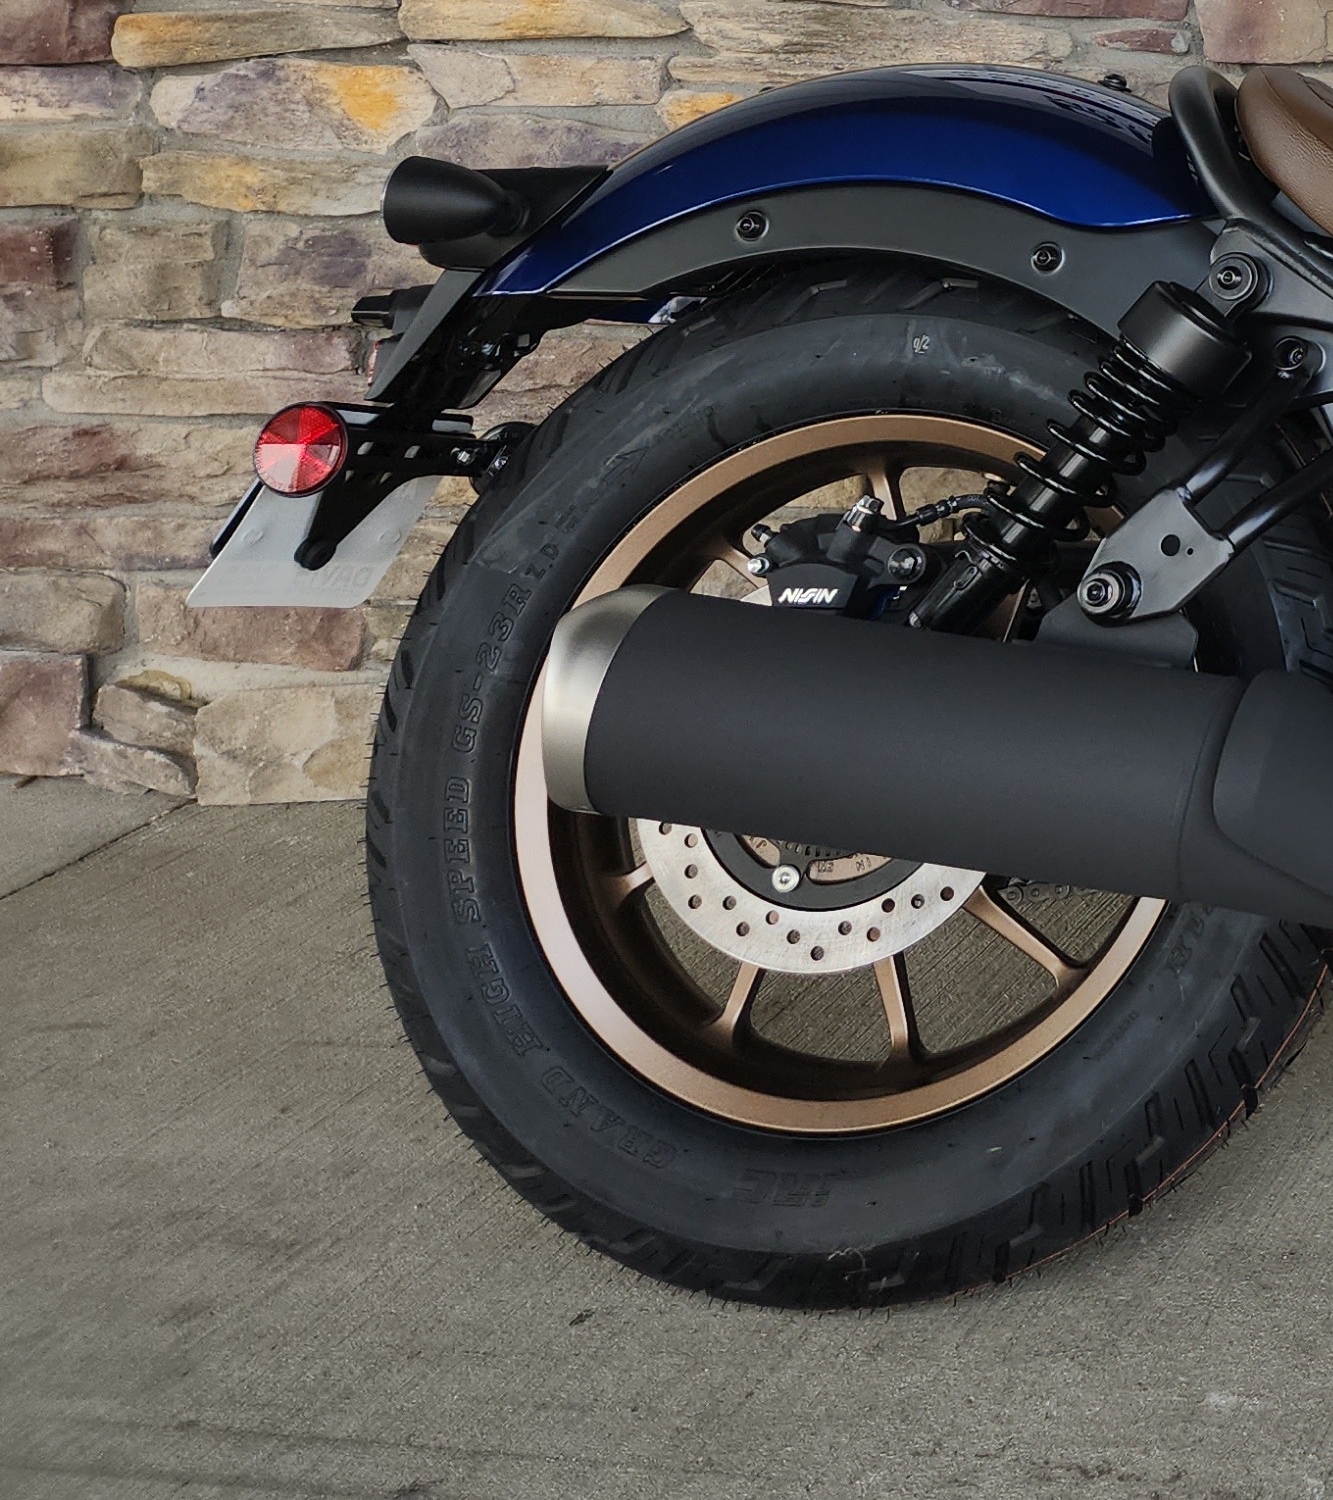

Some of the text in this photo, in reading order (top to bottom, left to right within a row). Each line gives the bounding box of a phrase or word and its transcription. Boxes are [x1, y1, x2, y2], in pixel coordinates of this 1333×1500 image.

[778, 587, 839, 604] NISSIN
[451, 577, 533, 754] GS-23R
[443, 775, 483, 930] SPEED
[462, 938, 544, 1064] HIGH
[536, 1059, 679, 1176] GRAND
